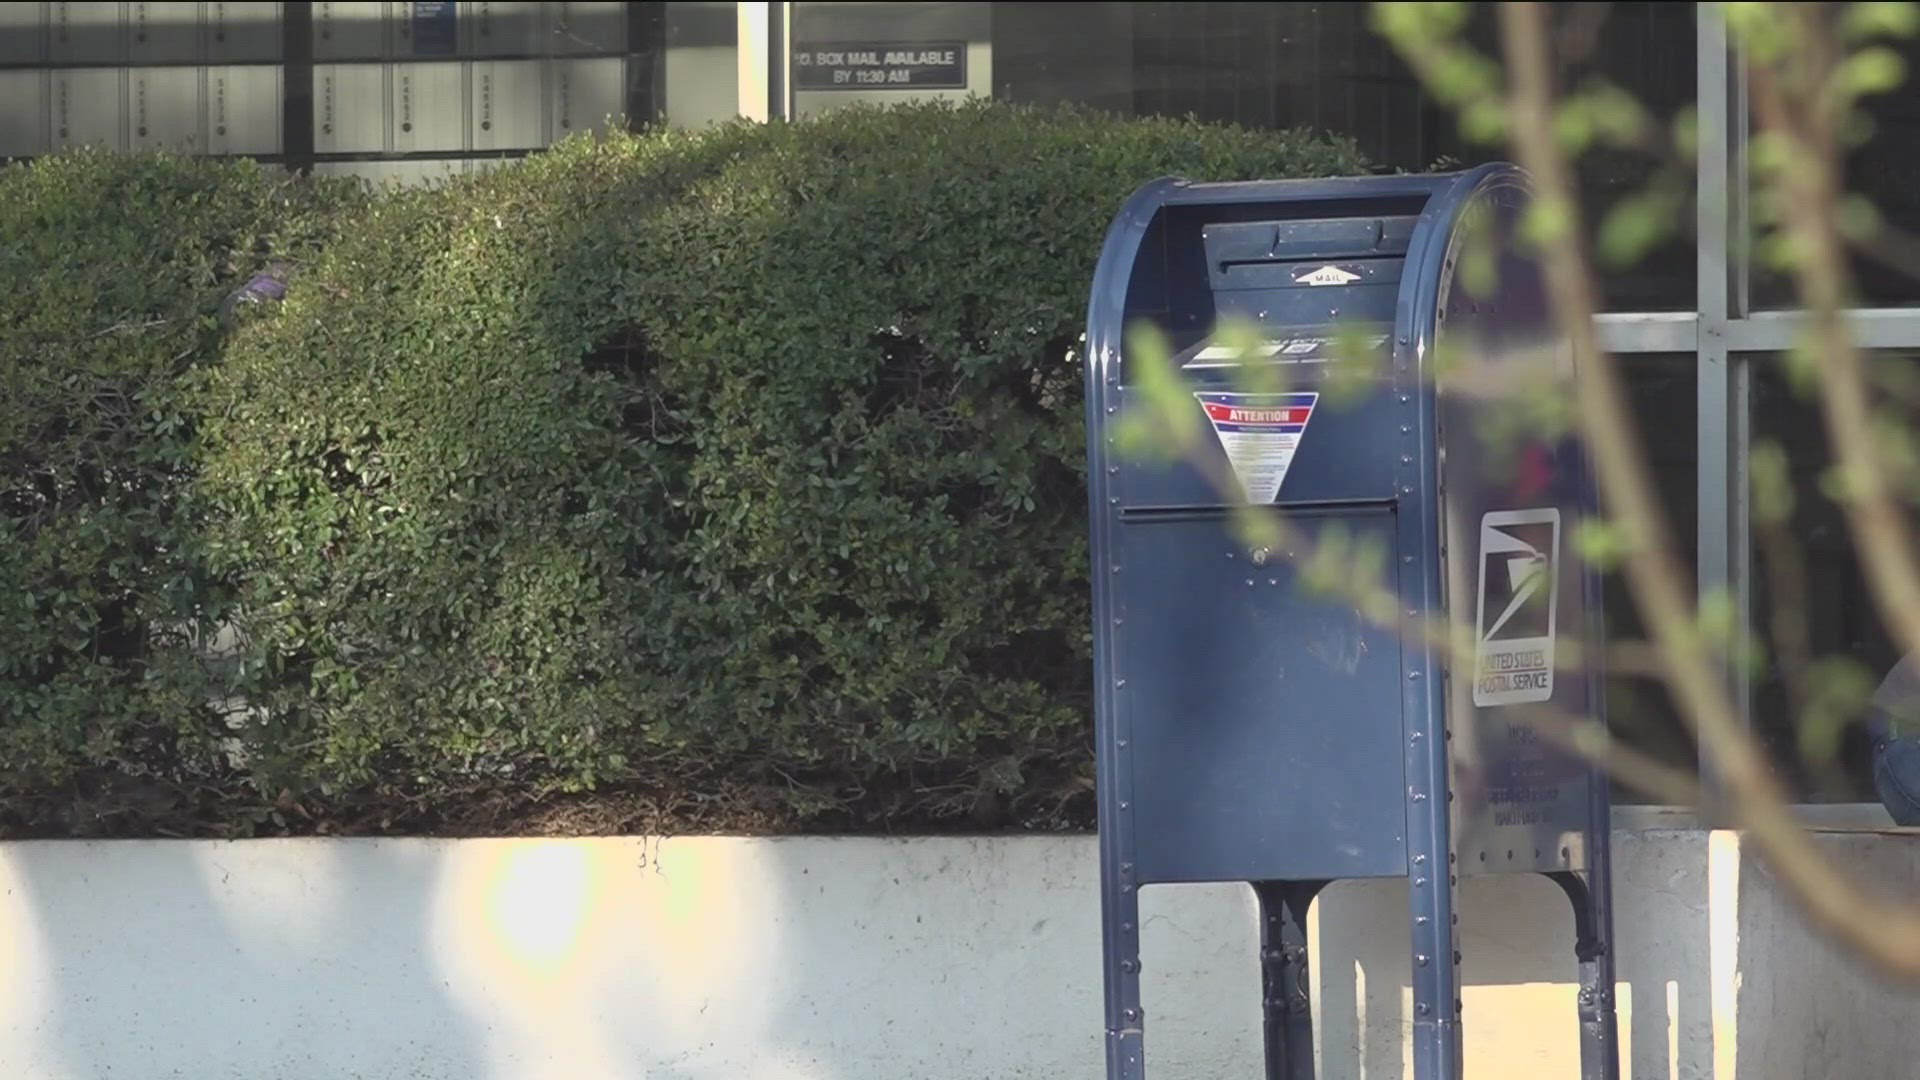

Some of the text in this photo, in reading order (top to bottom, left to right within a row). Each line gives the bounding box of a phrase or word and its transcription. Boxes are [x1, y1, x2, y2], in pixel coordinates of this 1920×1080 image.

[816, 52, 845, 66] BOX
[847, 52, 881, 66] MAIL
[883, 51, 955, 66] AVAILABLE
[833, 69, 851, 84] BY
[887, 68, 910, 83] AM
[1315, 273, 1342, 282] MAIL
[1229, 409, 1290, 422] ATTENTION
[1514, 650, 1544, 669] STATES
[1478, 672, 1549, 694] POSTAL SERVICE
